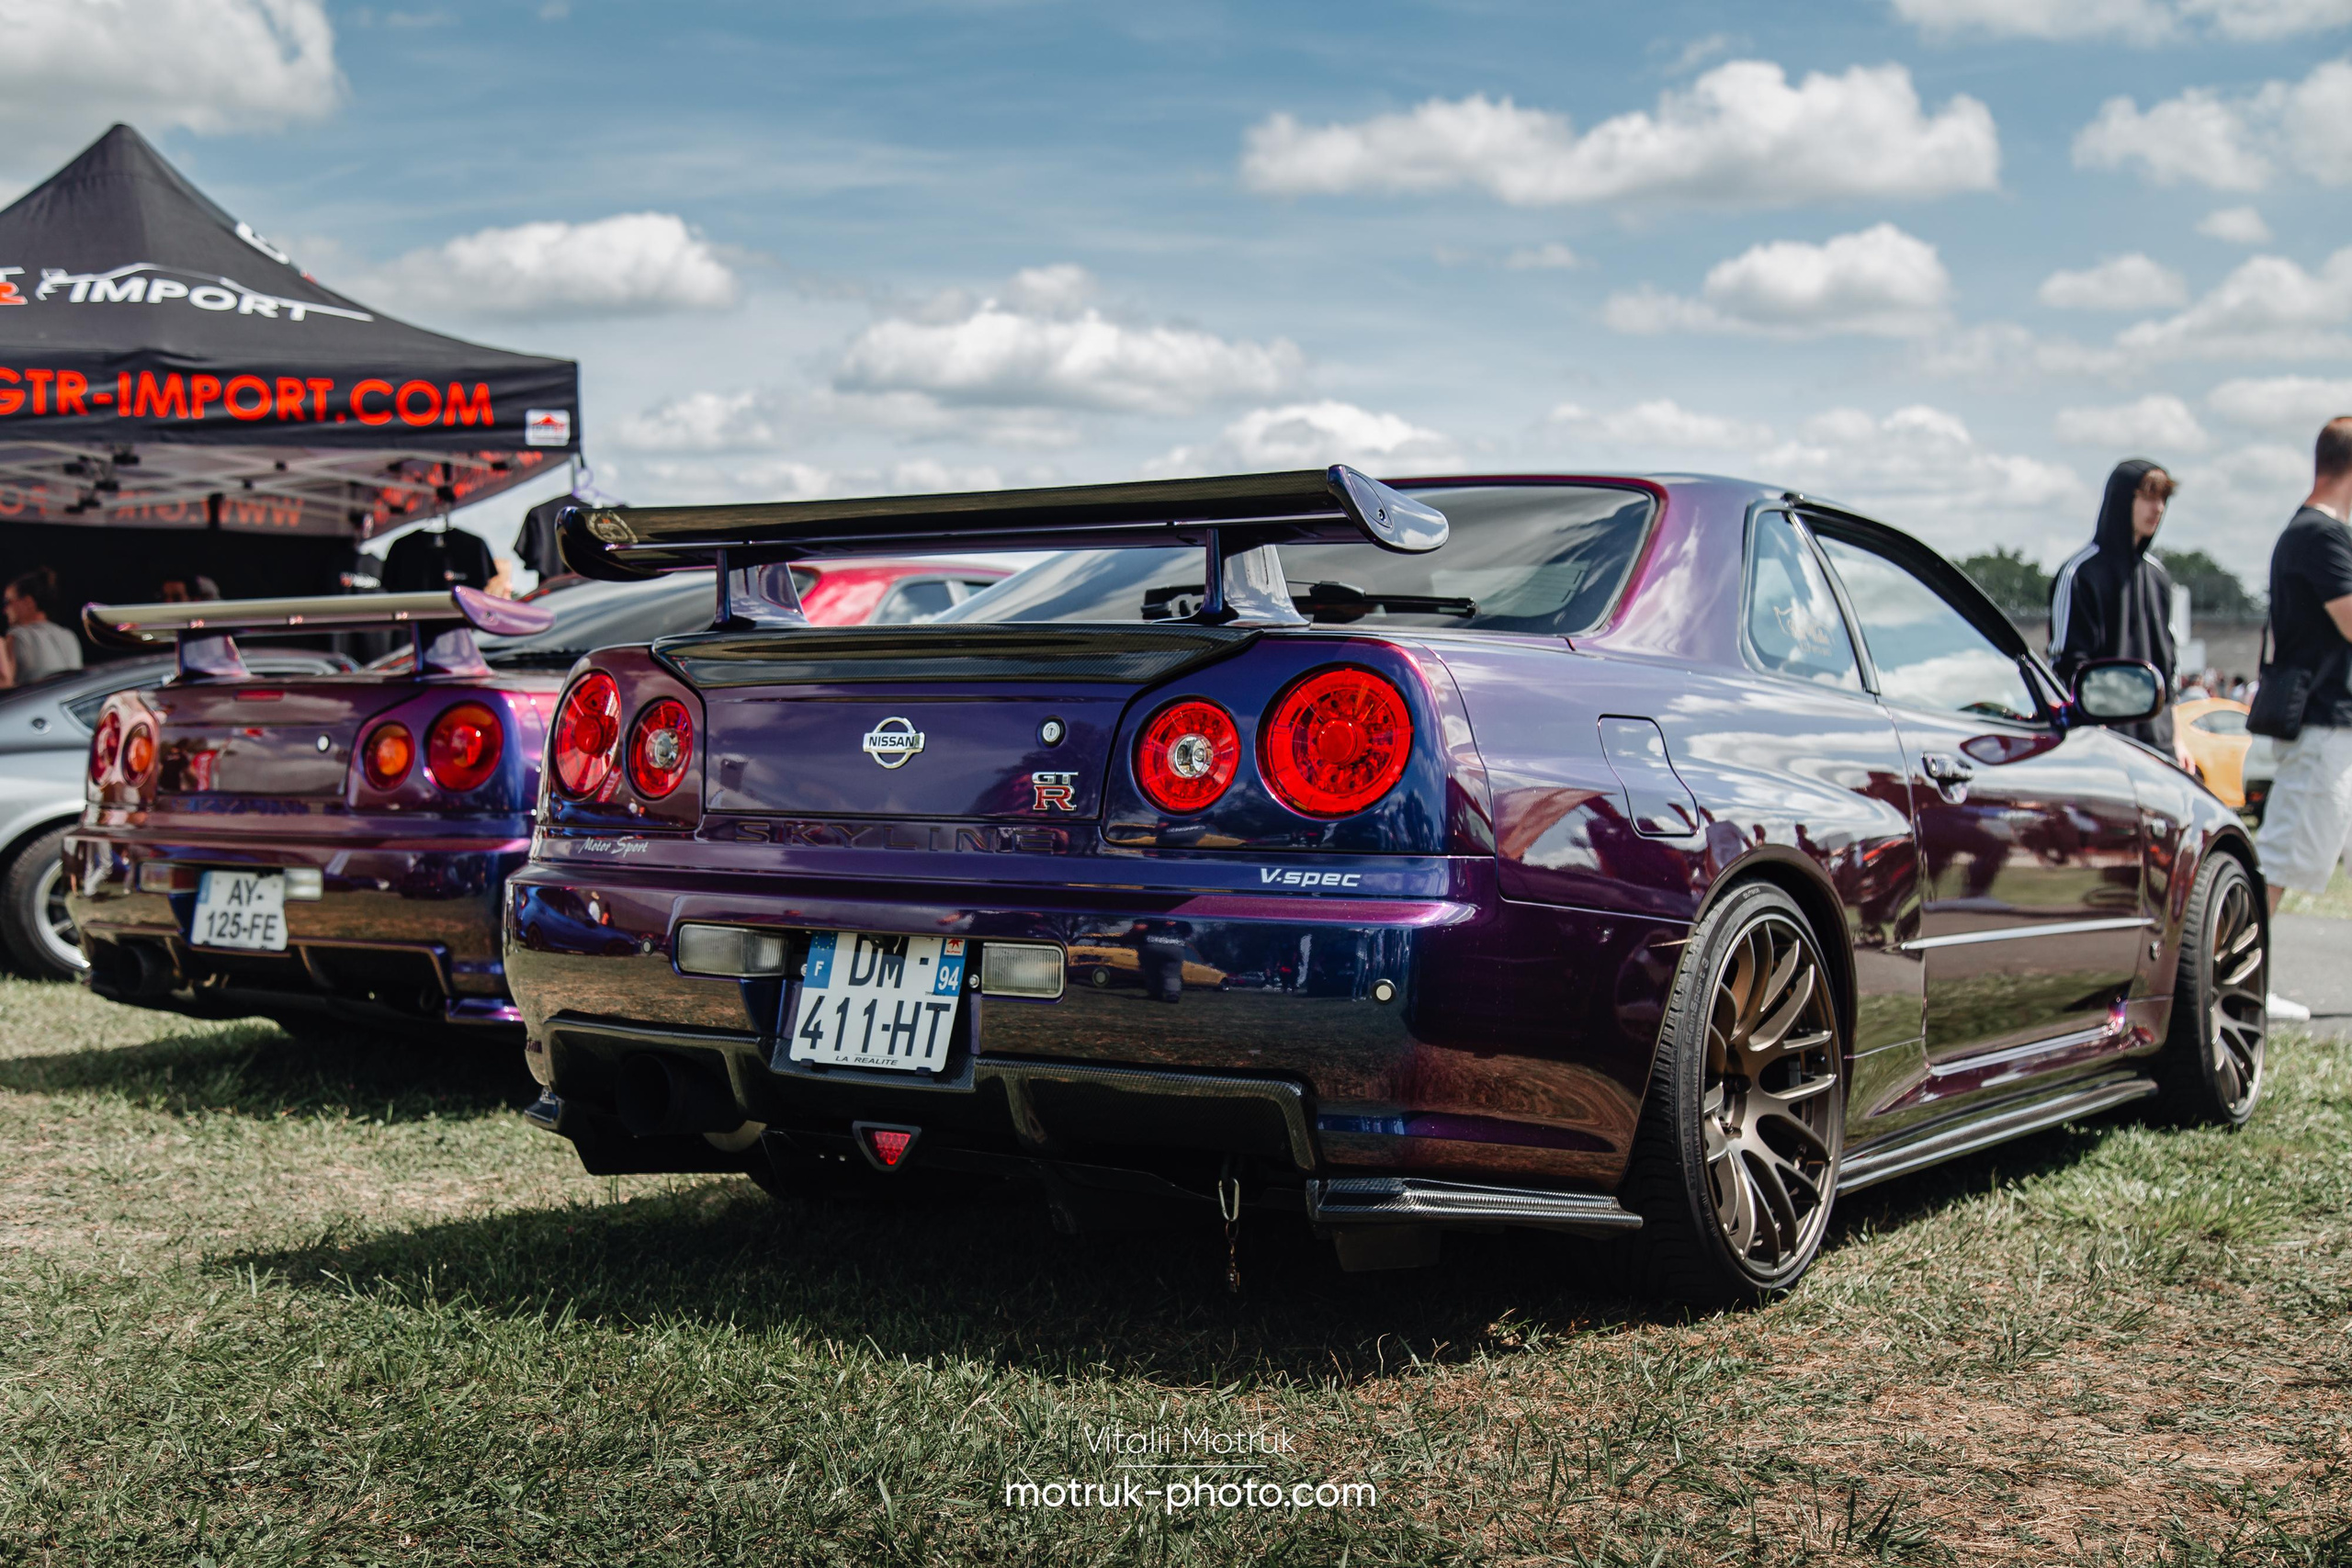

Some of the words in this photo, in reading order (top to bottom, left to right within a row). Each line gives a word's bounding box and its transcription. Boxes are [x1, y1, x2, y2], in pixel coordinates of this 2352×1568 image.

[69, 277, 307, 321] IMPORT
[869, 737, 915, 747] NISSAN
[1032, 772, 1079, 784] GT
[1033, 784, 1078, 811] R
[578, 837, 611, 853] Motor
[611, 836, 650, 857] Sport
[735, 820, 1057, 854] SKYLINE
[207, 910, 278, 942] 125-FE
[814, 961, 824, 976] F
[1702, 957, 1710, 968] 3
[938, 965, 960, 991] 94
[799, 995, 952, 1058] 411-HT
[854, 1056, 899, 1066] REALITE
